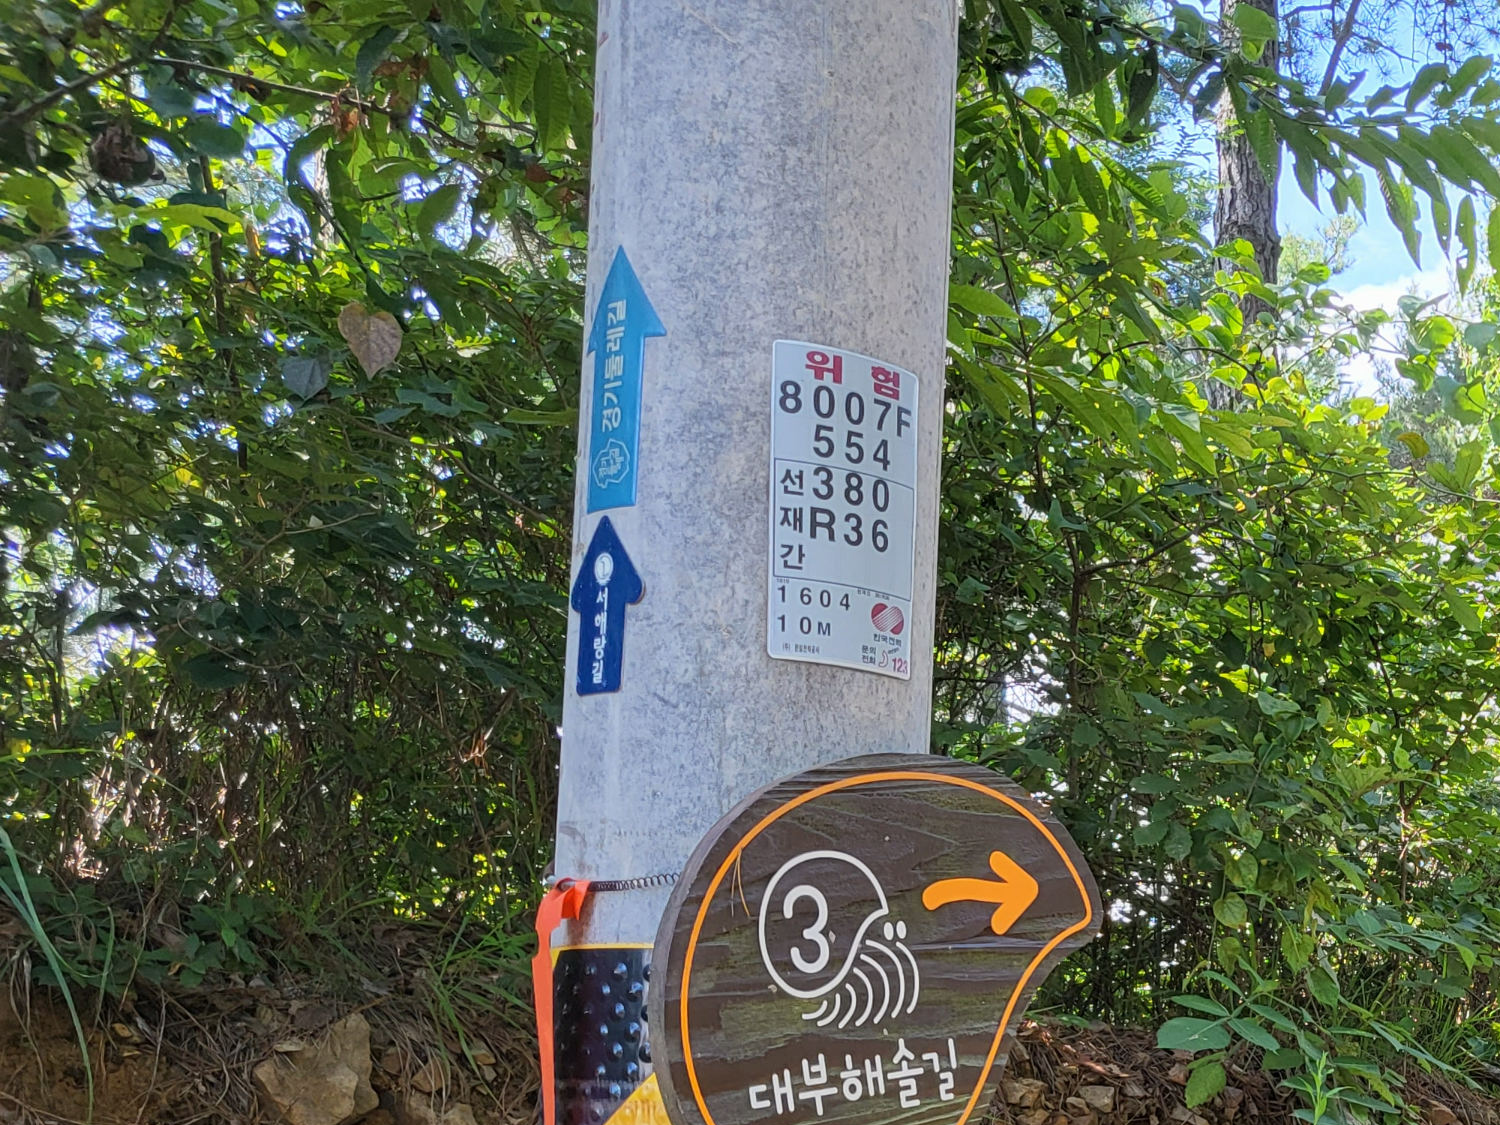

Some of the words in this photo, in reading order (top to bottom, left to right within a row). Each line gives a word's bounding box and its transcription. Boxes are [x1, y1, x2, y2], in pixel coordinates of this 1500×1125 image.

[601, 298, 627, 433] 경기둘레길
[805, 350, 901, 401] 위험
[779, 380, 912, 438] 8007F
[813, 424, 891, 472] 554
[812, 466, 890, 512] 380
[809, 507, 889, 553] R36
[777, 585, 851, 611] 1604
[592, 586, 608, 684] 서해랑길
[892, 658, 908, 675] 123
[783, 884, 830, 974] 3
[749, 1038, 958, 1117] 대부해솔길
